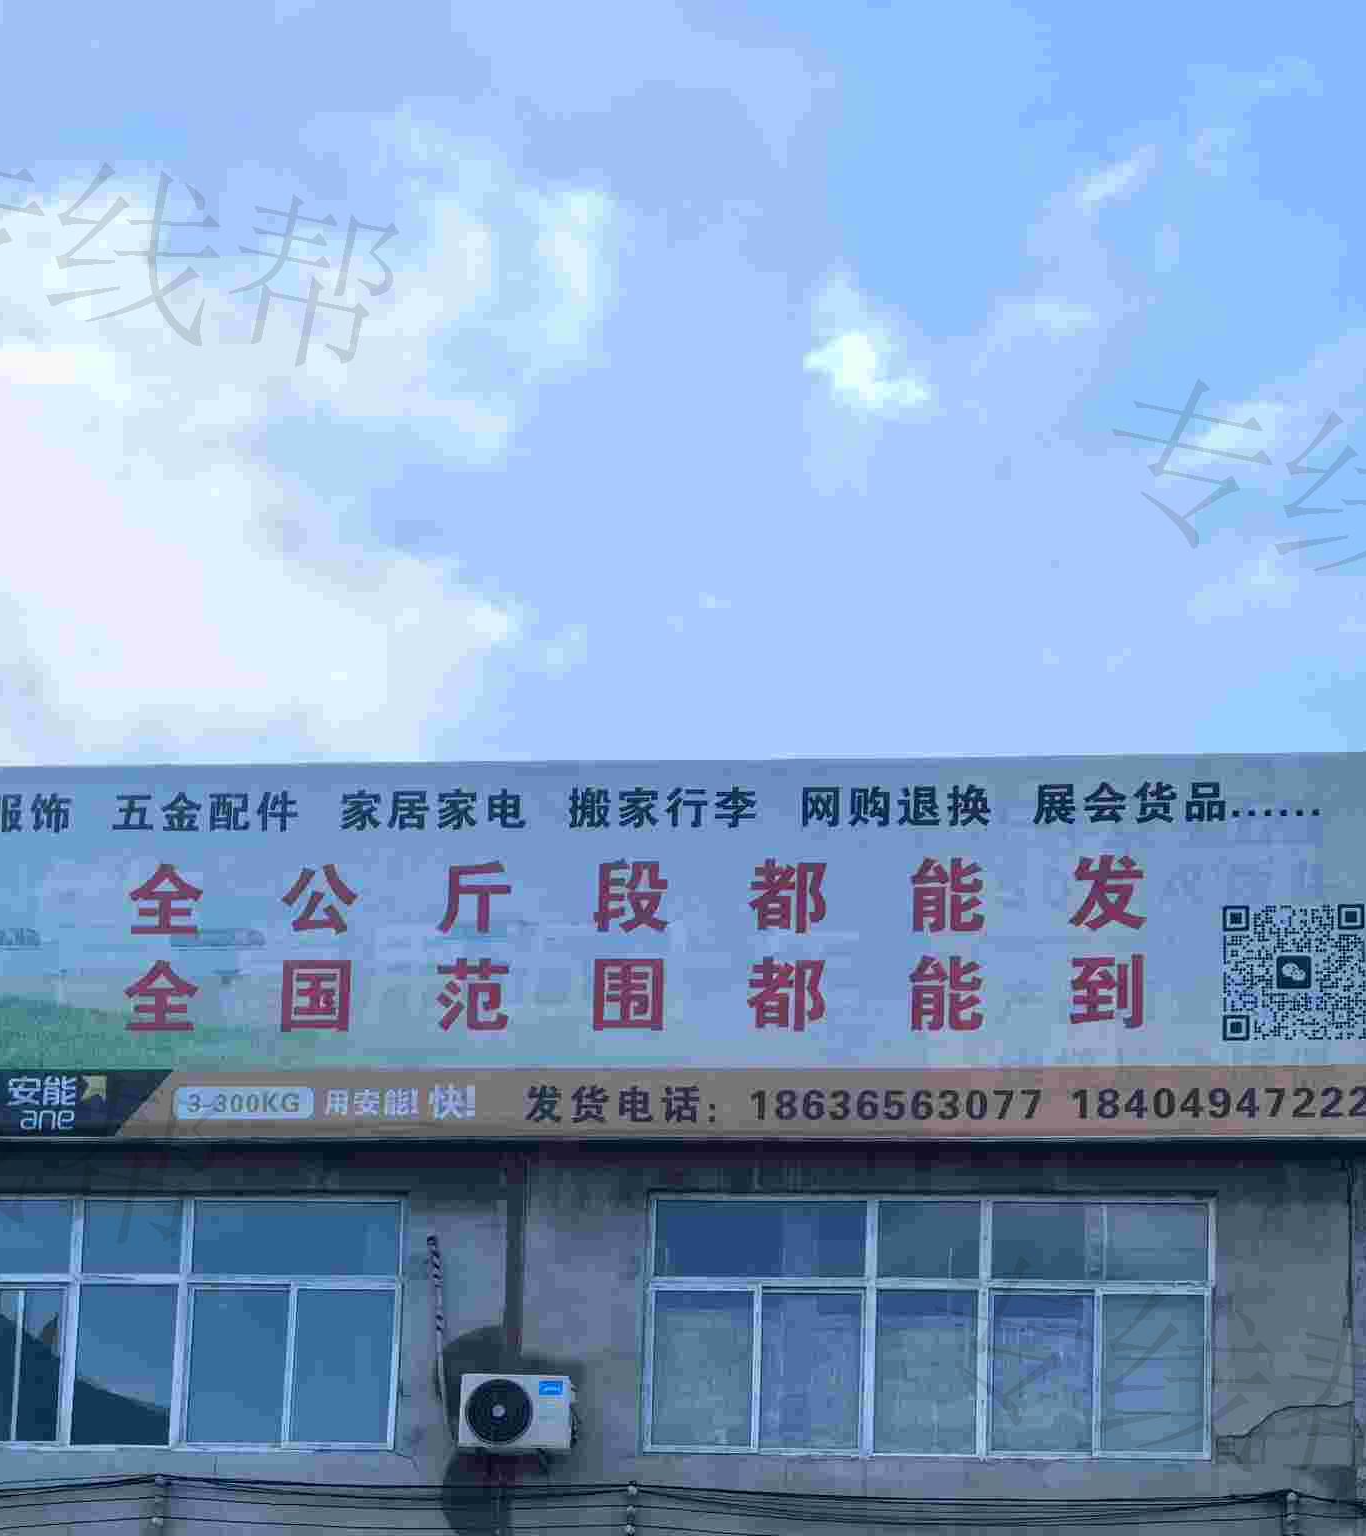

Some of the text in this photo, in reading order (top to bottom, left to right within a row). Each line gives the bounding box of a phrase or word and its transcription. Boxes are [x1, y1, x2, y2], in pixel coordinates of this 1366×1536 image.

[111, 789, 300, 834] 五金配件
[339, 786, 528, 832] 家居家电
[567, 784, 758, 830] 搬家行李
[801, 782, 993, 828] 网购退换
[128, 855, 1147, 938] 全公斤段都能发
[123, 953, 1146, 1034] 全国范围都能到
[7, 1075, 77, 1107] 安能
[187, 1092, 301, 1114] 3-300KG
[750, 1088, 1042, 1122] 18636563077
[19, 1109, 76, 1131] ane
